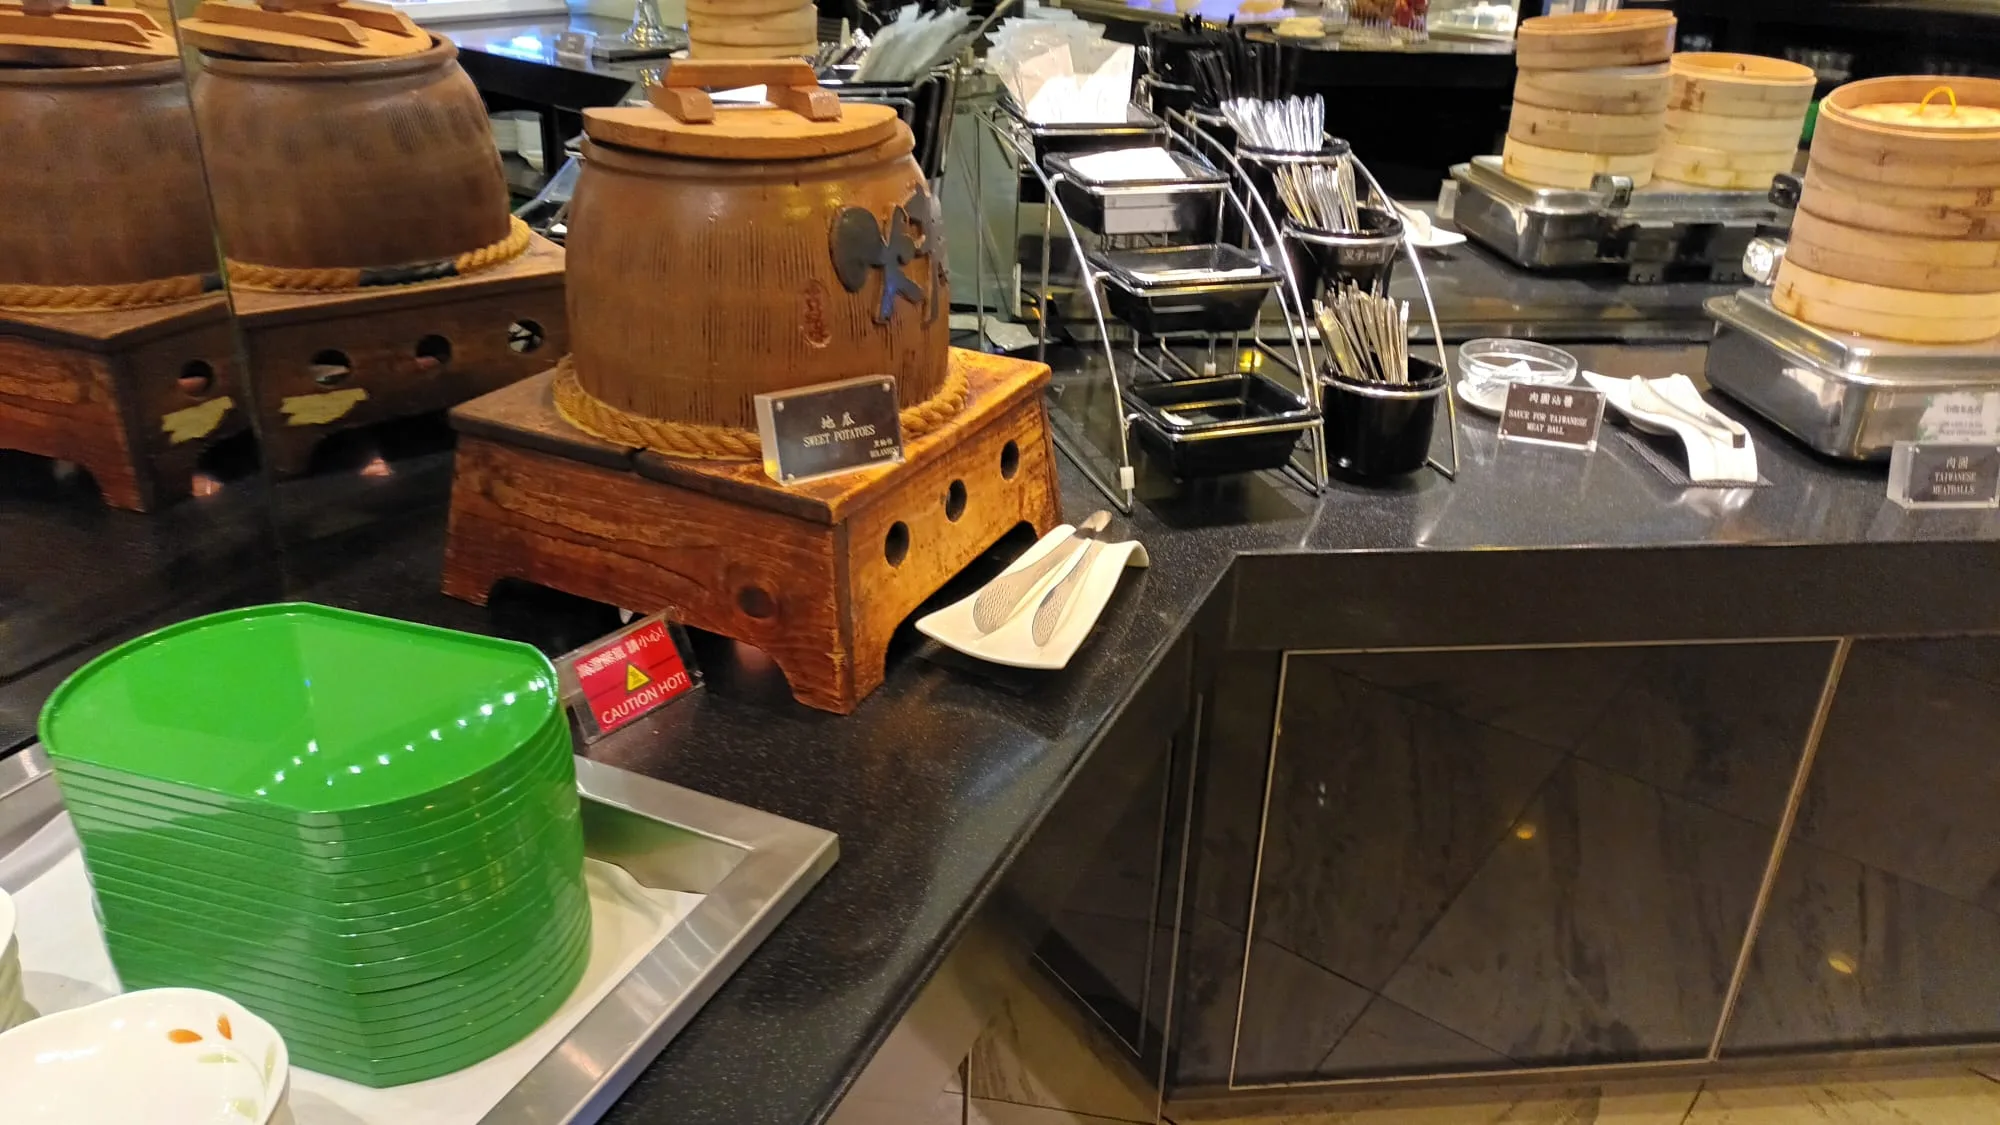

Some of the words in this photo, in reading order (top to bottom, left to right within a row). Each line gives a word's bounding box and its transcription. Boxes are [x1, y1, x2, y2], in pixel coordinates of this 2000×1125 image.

[1508, 409, 1530, 420] SAUCE
[1533, 412, 1546, 422] FOR
[1550, 414, 1587, 427] TAIWANESE
[803, 433, 830, 447] SWEET
[833, 424, 876, 442] POTATOES
[1526, 422, 1544, 432] MEAT
[1547, 425, 1565, 435] BALL
[1935, 471, 1977, 482] TAIWANESE
[1932, 485, 1976, 496] MEATBALLS
[602, 687, 659, 724] CAUTION
[658, 671, 688, 695] HOT!
